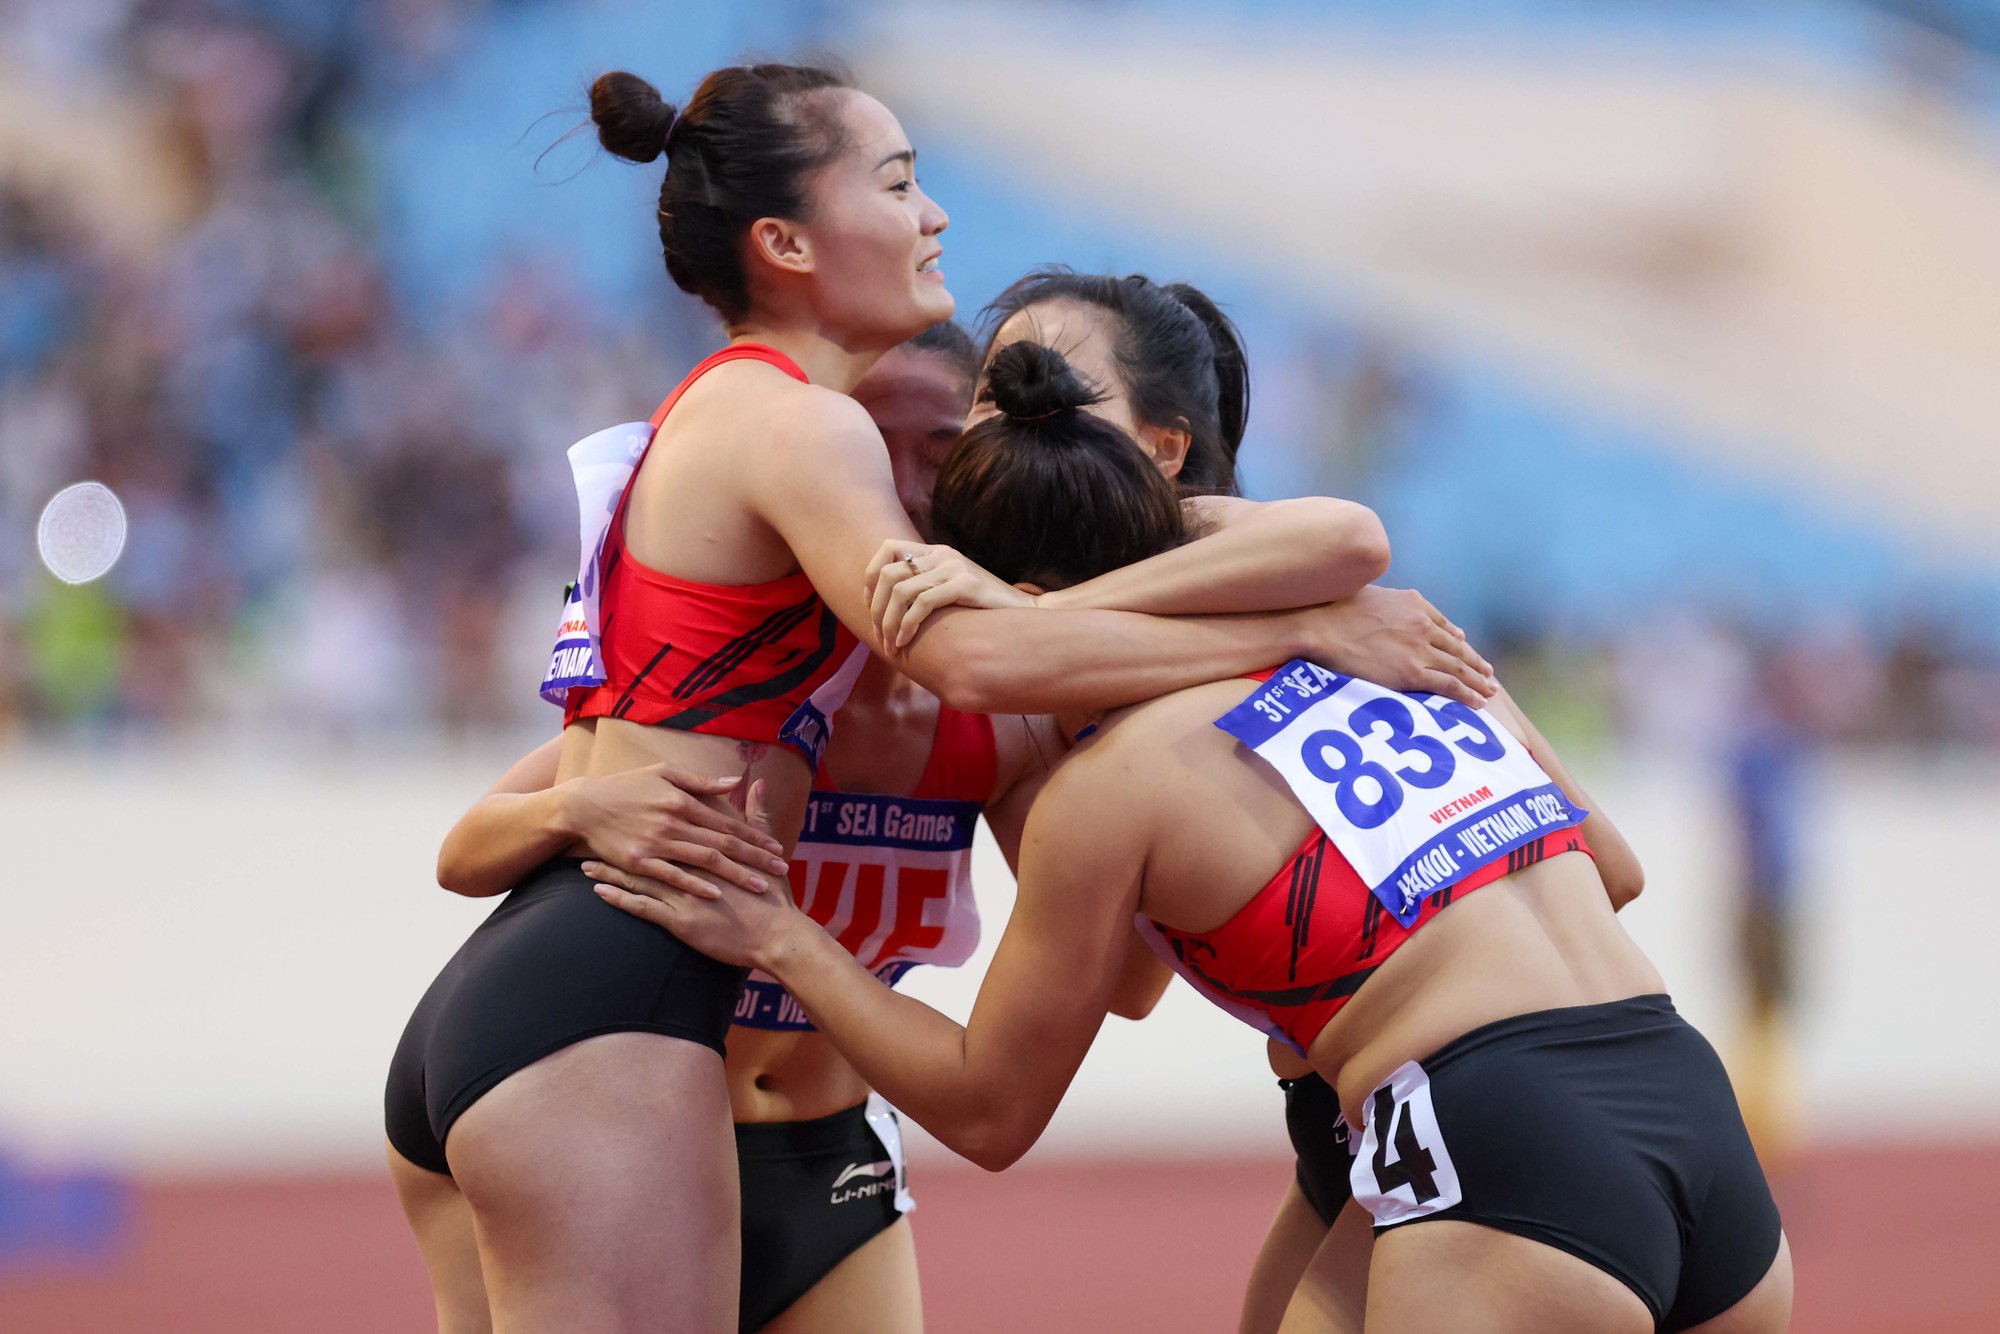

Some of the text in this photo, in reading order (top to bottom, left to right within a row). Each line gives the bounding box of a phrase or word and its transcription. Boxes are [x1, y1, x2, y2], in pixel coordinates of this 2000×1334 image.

[1283, 662, 1337, 698] SEA
[1301, 697, 1506, 829] 835
[808, 801, 956, 843] 1ST SEA Games
[1430, 786, 1494, 824] VIETNAM
[1397, 844, 1460, 906] HANOI
[1457, 804, 1538, 858] VIETNAM
[1526, 794, 1569, 826] 2022
[1372, 1084, 1441, 1206] 4
